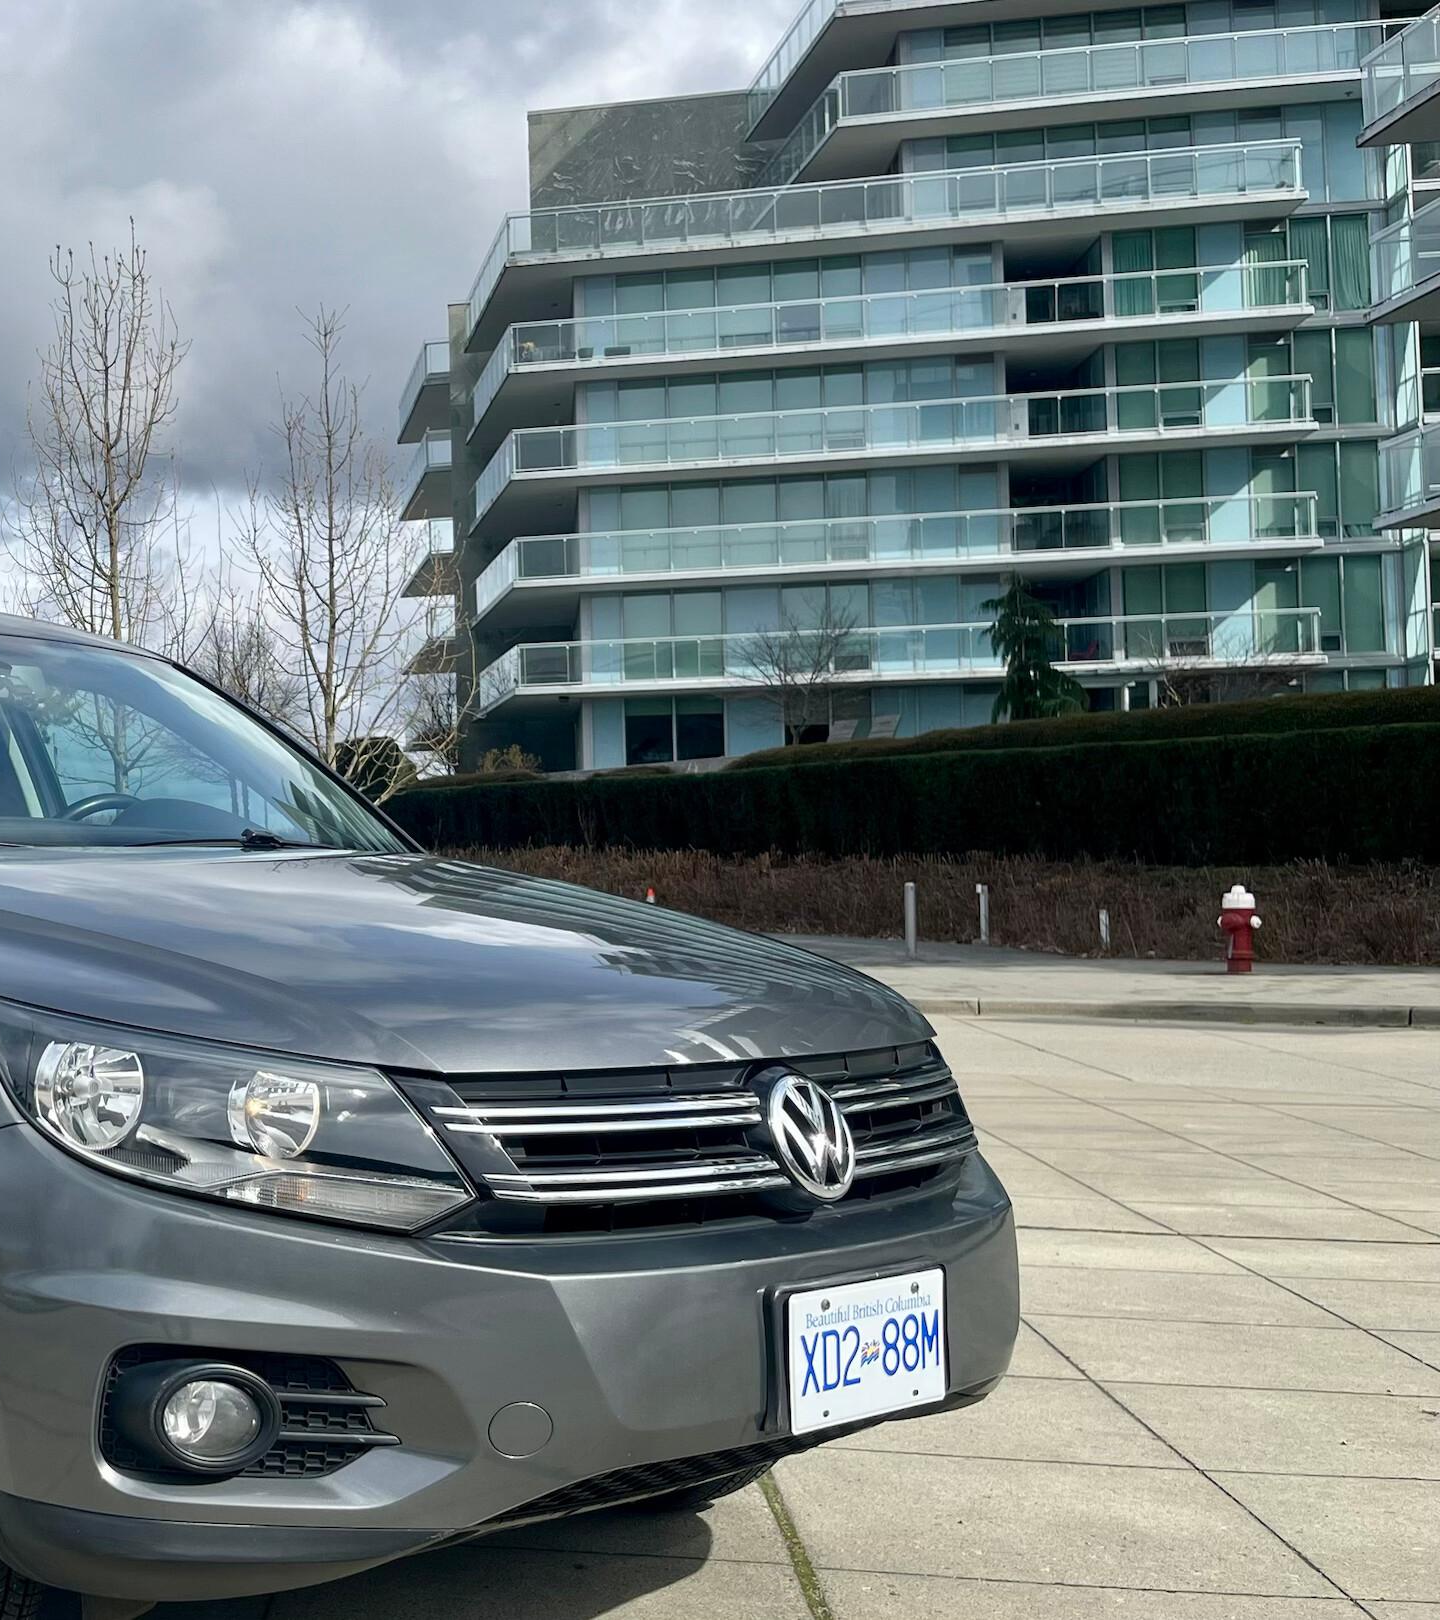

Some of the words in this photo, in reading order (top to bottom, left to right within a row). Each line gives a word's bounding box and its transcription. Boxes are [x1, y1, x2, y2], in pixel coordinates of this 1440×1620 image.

[771, 1077, 853, 1196] VW
[800, 1325, 861, 1397] XD2
[882, 1309, 940, 1376] 88M
[805, 1308, 850, 1329] Beautiful
[852, 1301, 884, 1320] British
[884, 1293, 931, 1314] Columbia
